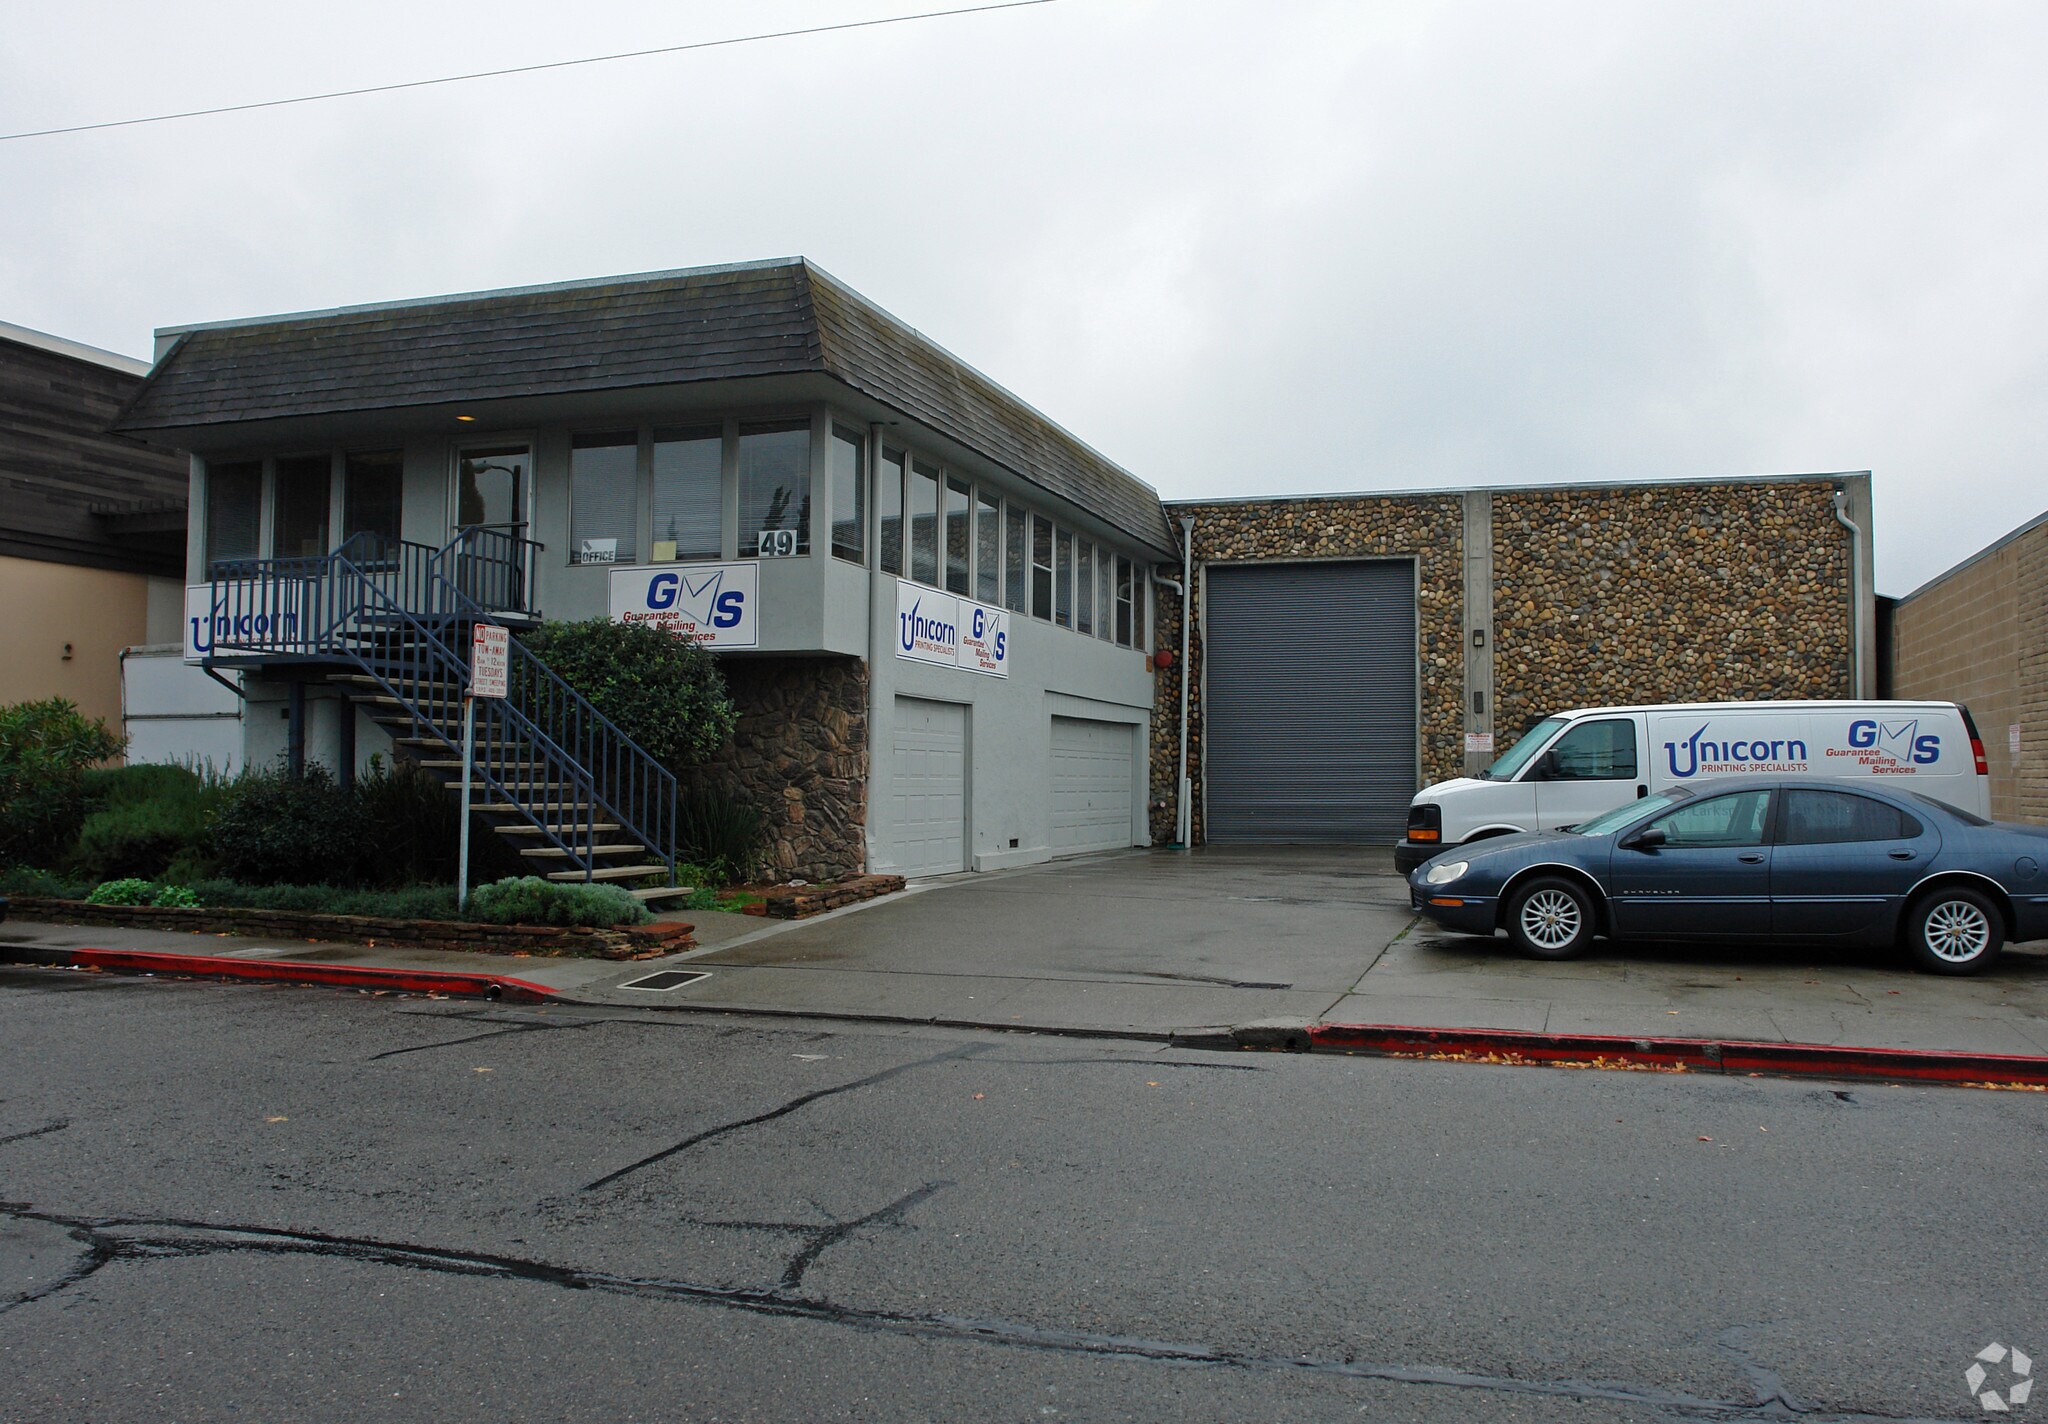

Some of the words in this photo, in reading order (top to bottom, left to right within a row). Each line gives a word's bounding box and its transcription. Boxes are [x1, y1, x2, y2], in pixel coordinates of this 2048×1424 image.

[760, 531, 793, 556] 49
[582, 550, 614, 562] OFFICE
[623, 611, 679, 621] Guarantee
[901, 596, 955, 651] Unicorn
[476, 626, 485, 641] NO
[486, 630, 507, 643] PARKING
[671, 630, 716, 641] Sevices
[479, 666, 504, 678] TUESDAYS
[1664, 721, 1807, 778] Unicorn
[1826, 748, 1880, 757] Guarantee
[1859, 756, 1896, 767] Mailing
[1701, 764, 1746, 773] PRINTING
[1749, 763, 1808, 772] SPECIALISTS
[1872, 765, 1916, 774] Services
